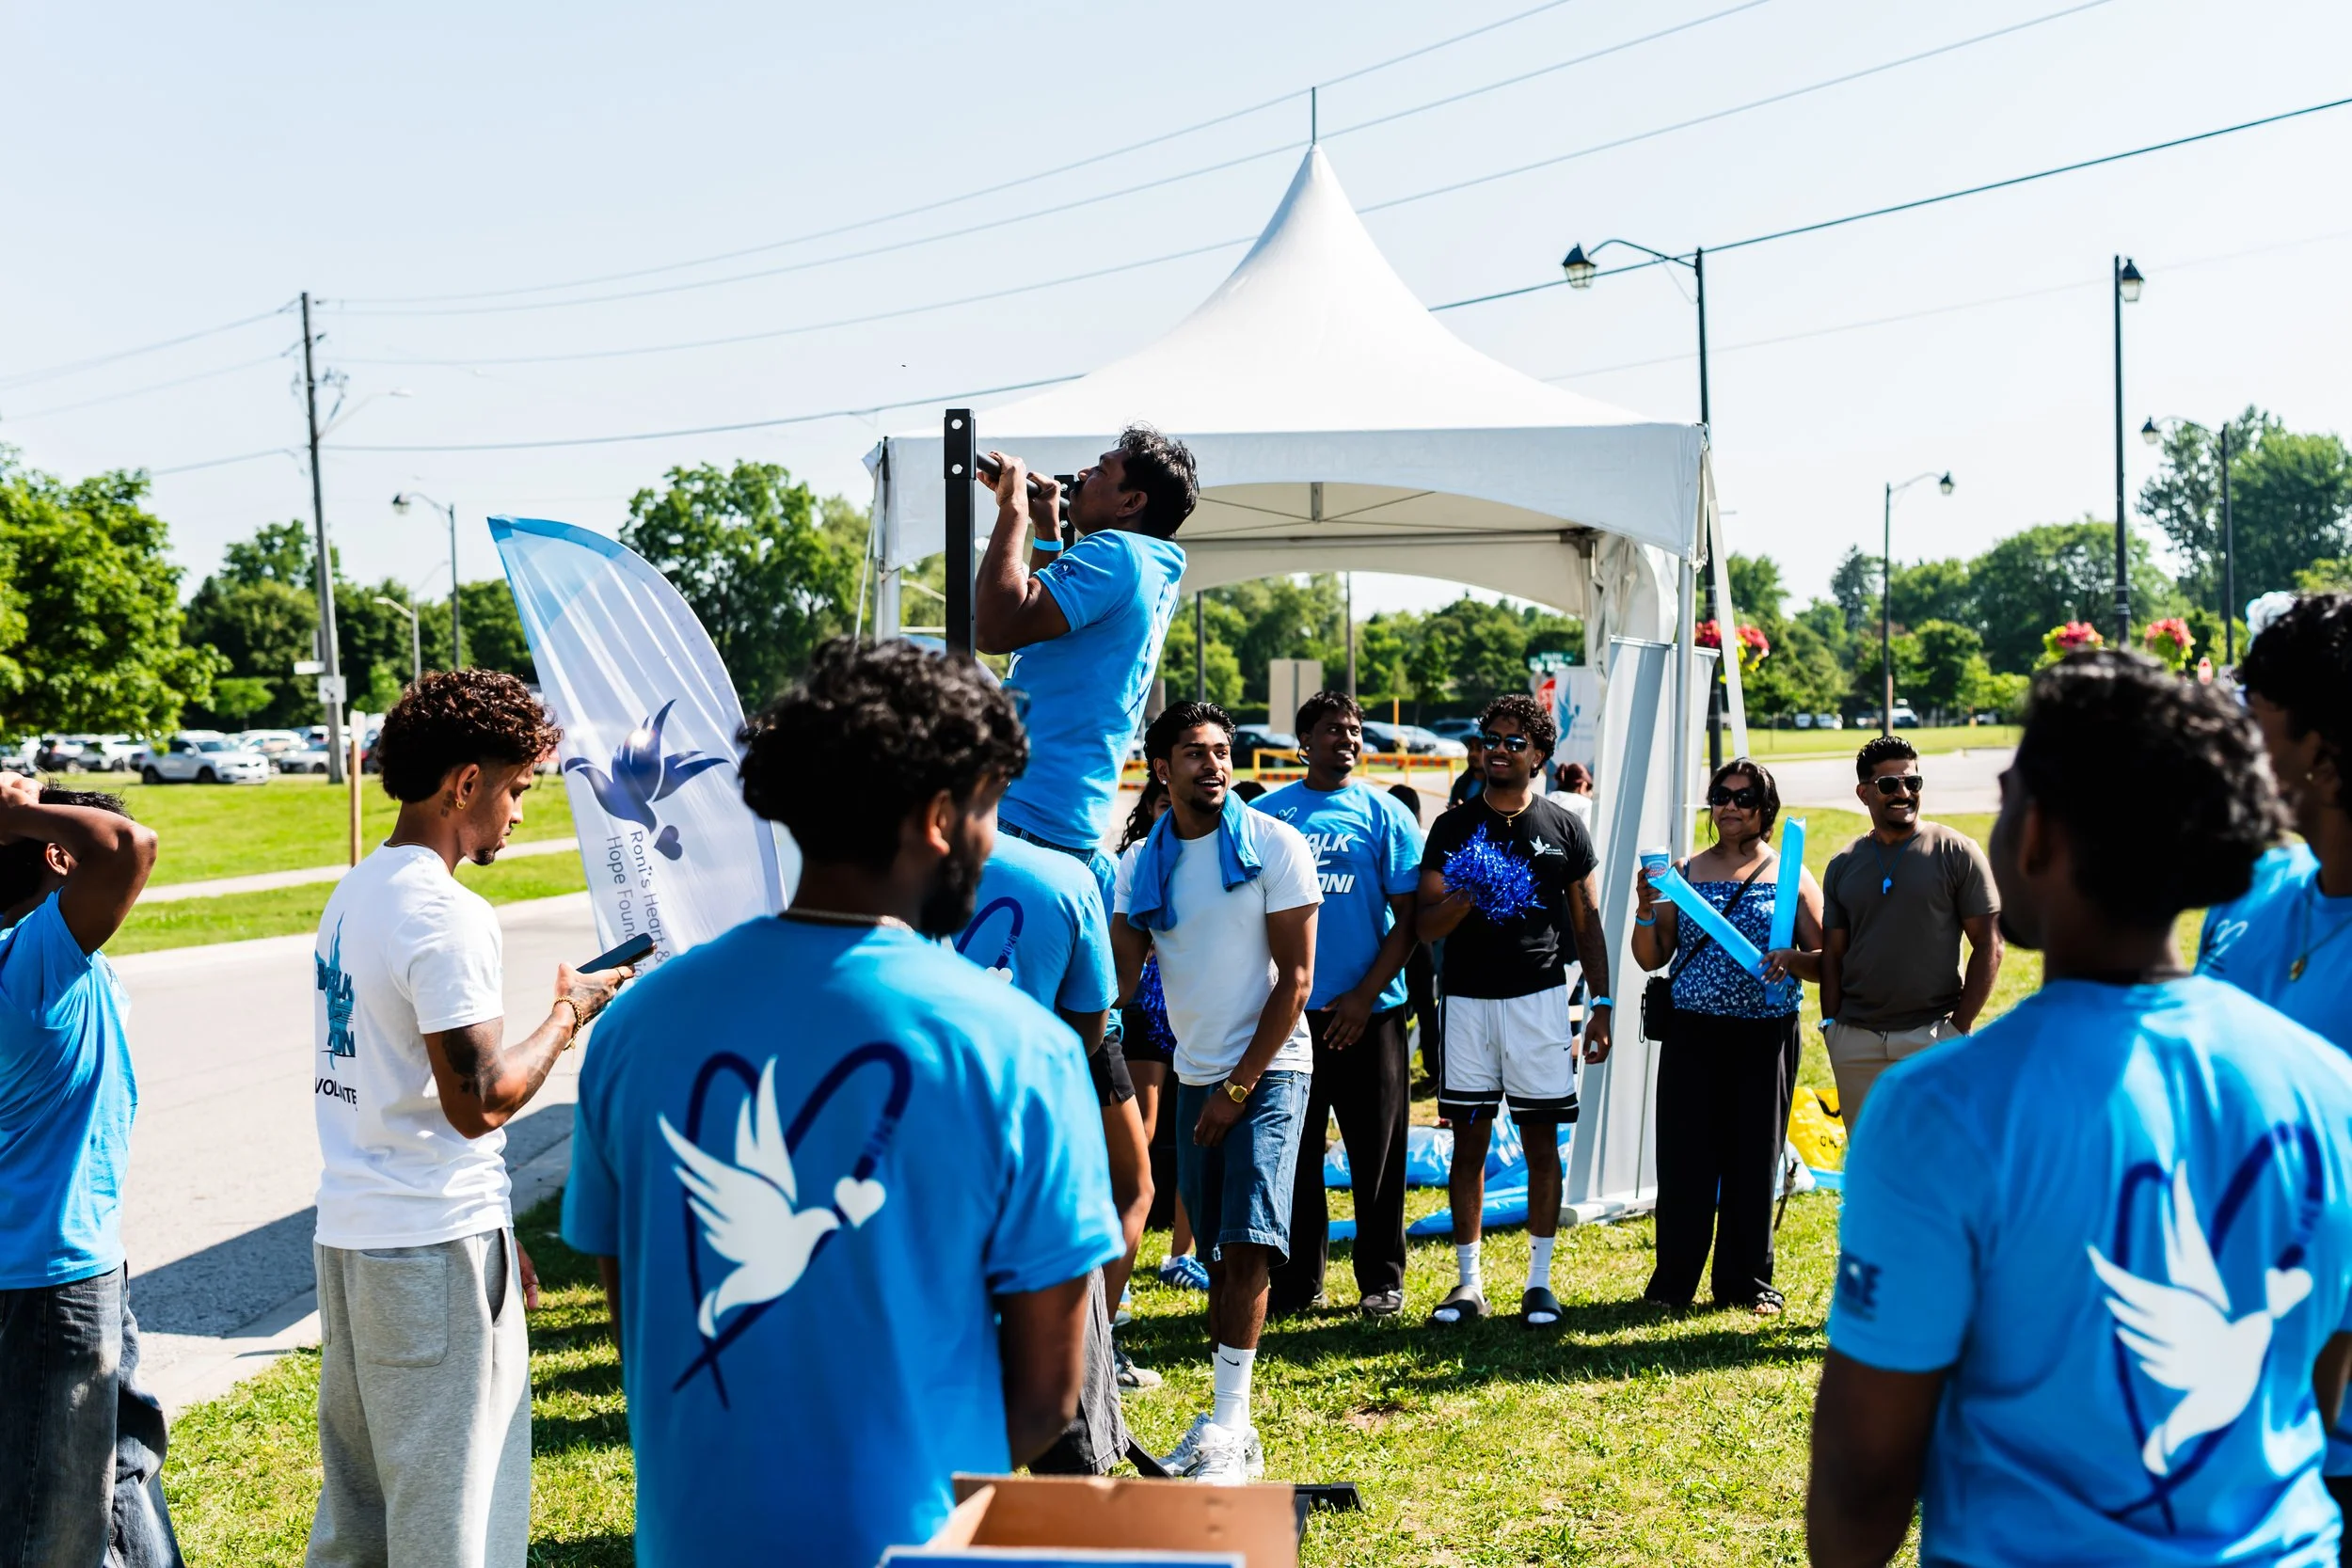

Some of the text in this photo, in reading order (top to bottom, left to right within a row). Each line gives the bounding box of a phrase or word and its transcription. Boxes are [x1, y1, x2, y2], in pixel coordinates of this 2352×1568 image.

[607, 836, 644, 979] Hope Founio
[630, 830, 671, 964] Roni's Heart &
[1303, 833, 1355, 852] ALK
